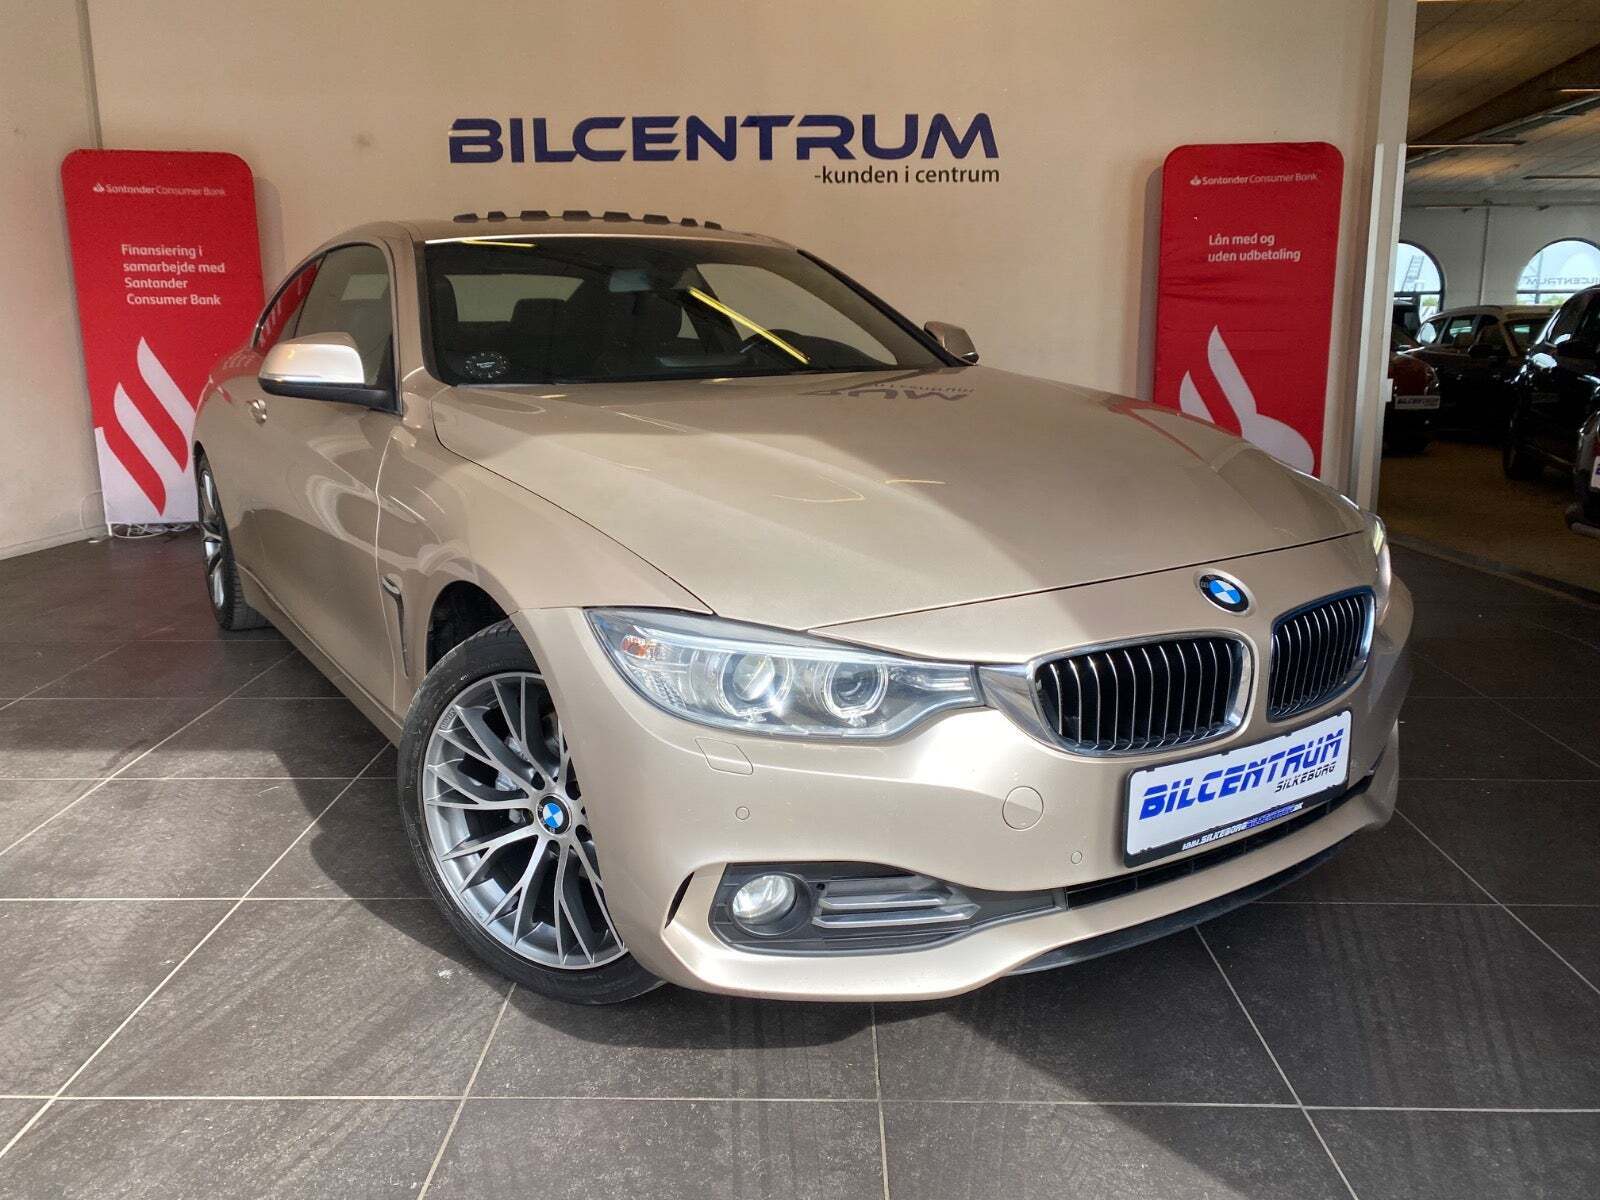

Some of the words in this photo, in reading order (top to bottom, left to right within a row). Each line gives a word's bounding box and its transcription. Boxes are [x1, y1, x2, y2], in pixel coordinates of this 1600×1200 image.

[449, 112, 999, 164] BILCENTRUM
[814, 165, 899, 184] -kunden
[904, 165, 910, 184] i
[915, 166, 1000, 184] centrum
[1202, 174, 1248, 186] Santander
[1295, 172, 1318, 182] Bank
[105, 184, 155, 195] Santander
[203, 187, 225, 196] Bank
[1209, 233, 1230, 246] Lån
[1232, 233, 1257, 245] med
[1260, 234, 1275, 246] og
[121, 243, 196, 260] Finansiering
[199, 245, 203, 257] i
[1208, 250, 1237, 263] uden
[1239, 248, 1301, 262] udbetaling
[123, 261, 195, 275] samarbejde
[198, 262, 225, 273] med
[124, 276, 188, 289] Santander
[126, 293, 187, 305] Consumer
[190, 294, 221, 305] Bank
[1138, 728, 1344, 821] BILCENTRUM
[1273, 761, 1337, 793] SILKEBORG
